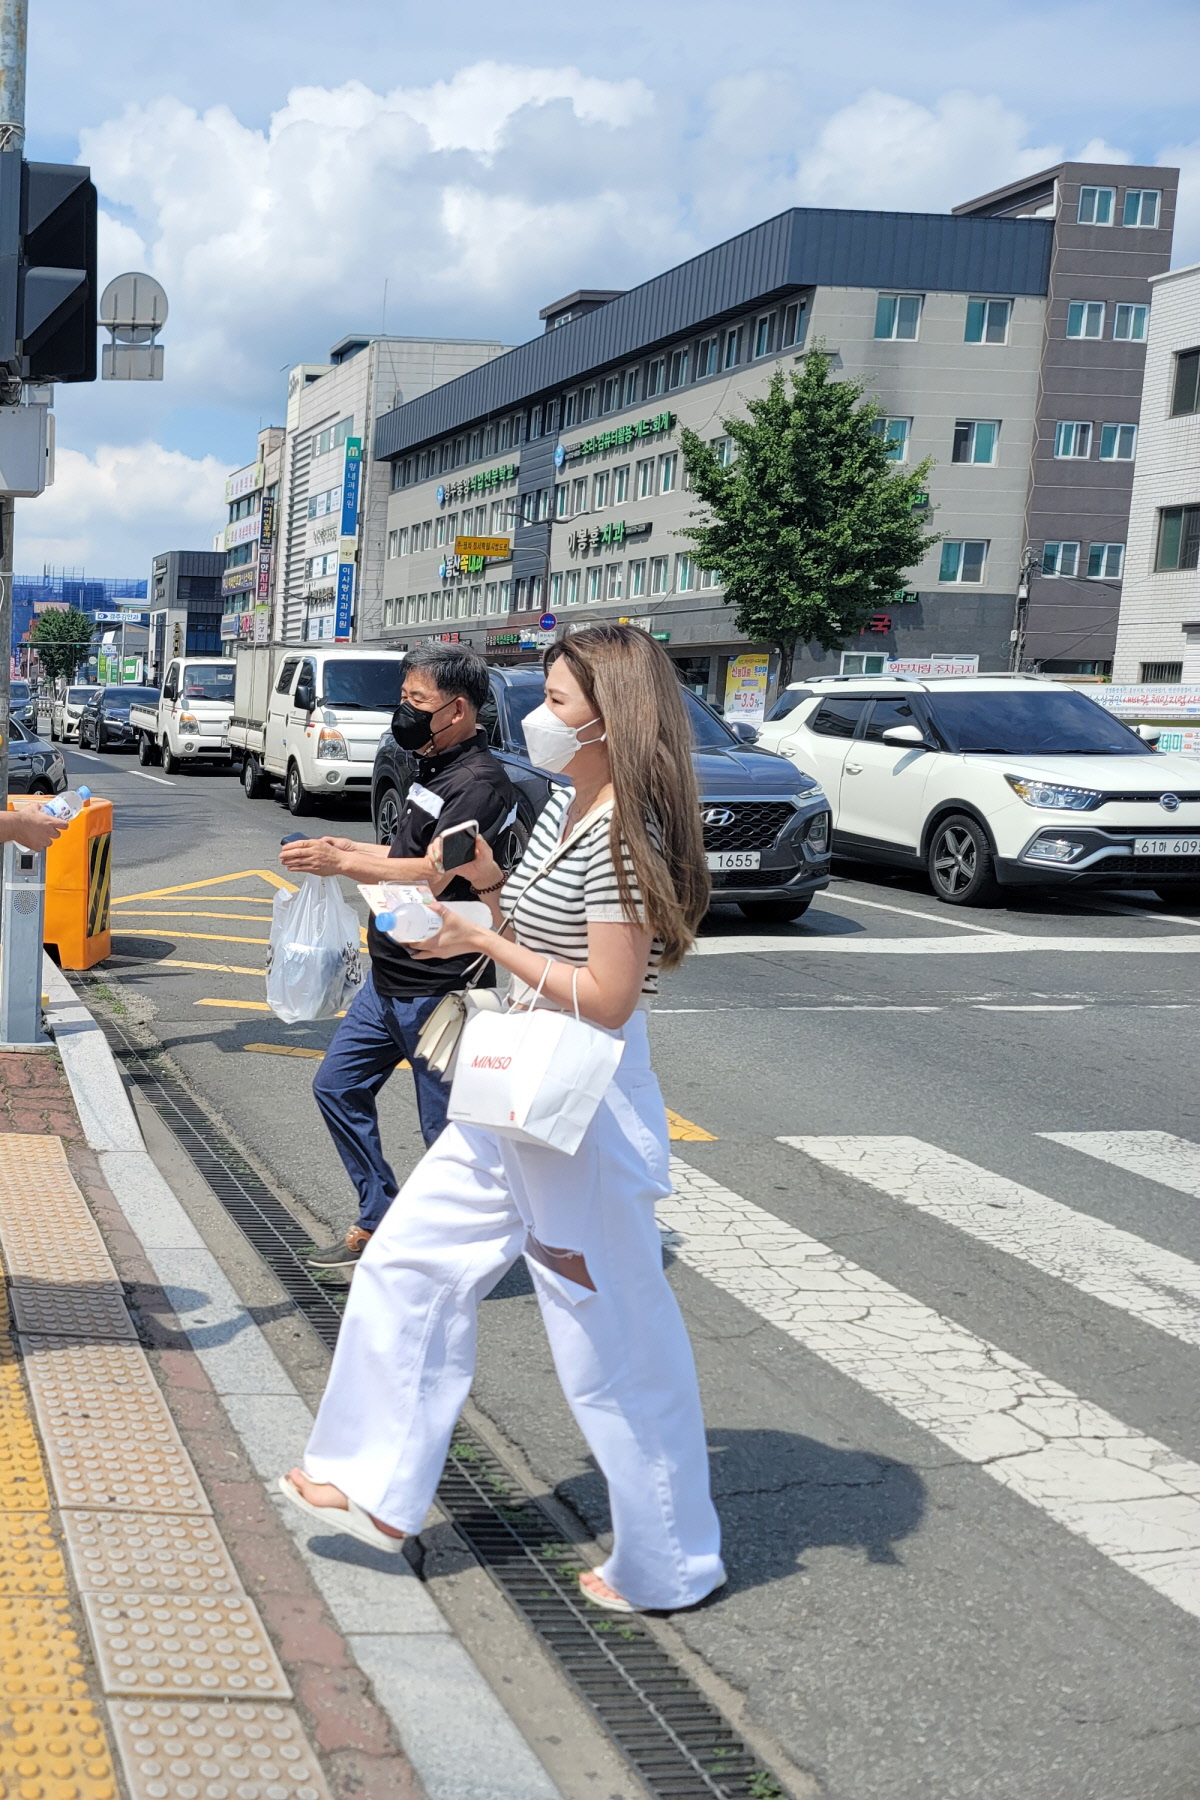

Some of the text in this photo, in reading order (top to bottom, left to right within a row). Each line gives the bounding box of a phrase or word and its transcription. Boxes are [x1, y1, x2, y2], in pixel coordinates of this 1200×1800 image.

[889, 663, 931, 674] 외부차량
[1141, 841, 1200, 853] 61하 609
[718, 854, 753, 868] 1655
[471, 1055, 513, 1070] MINISO
